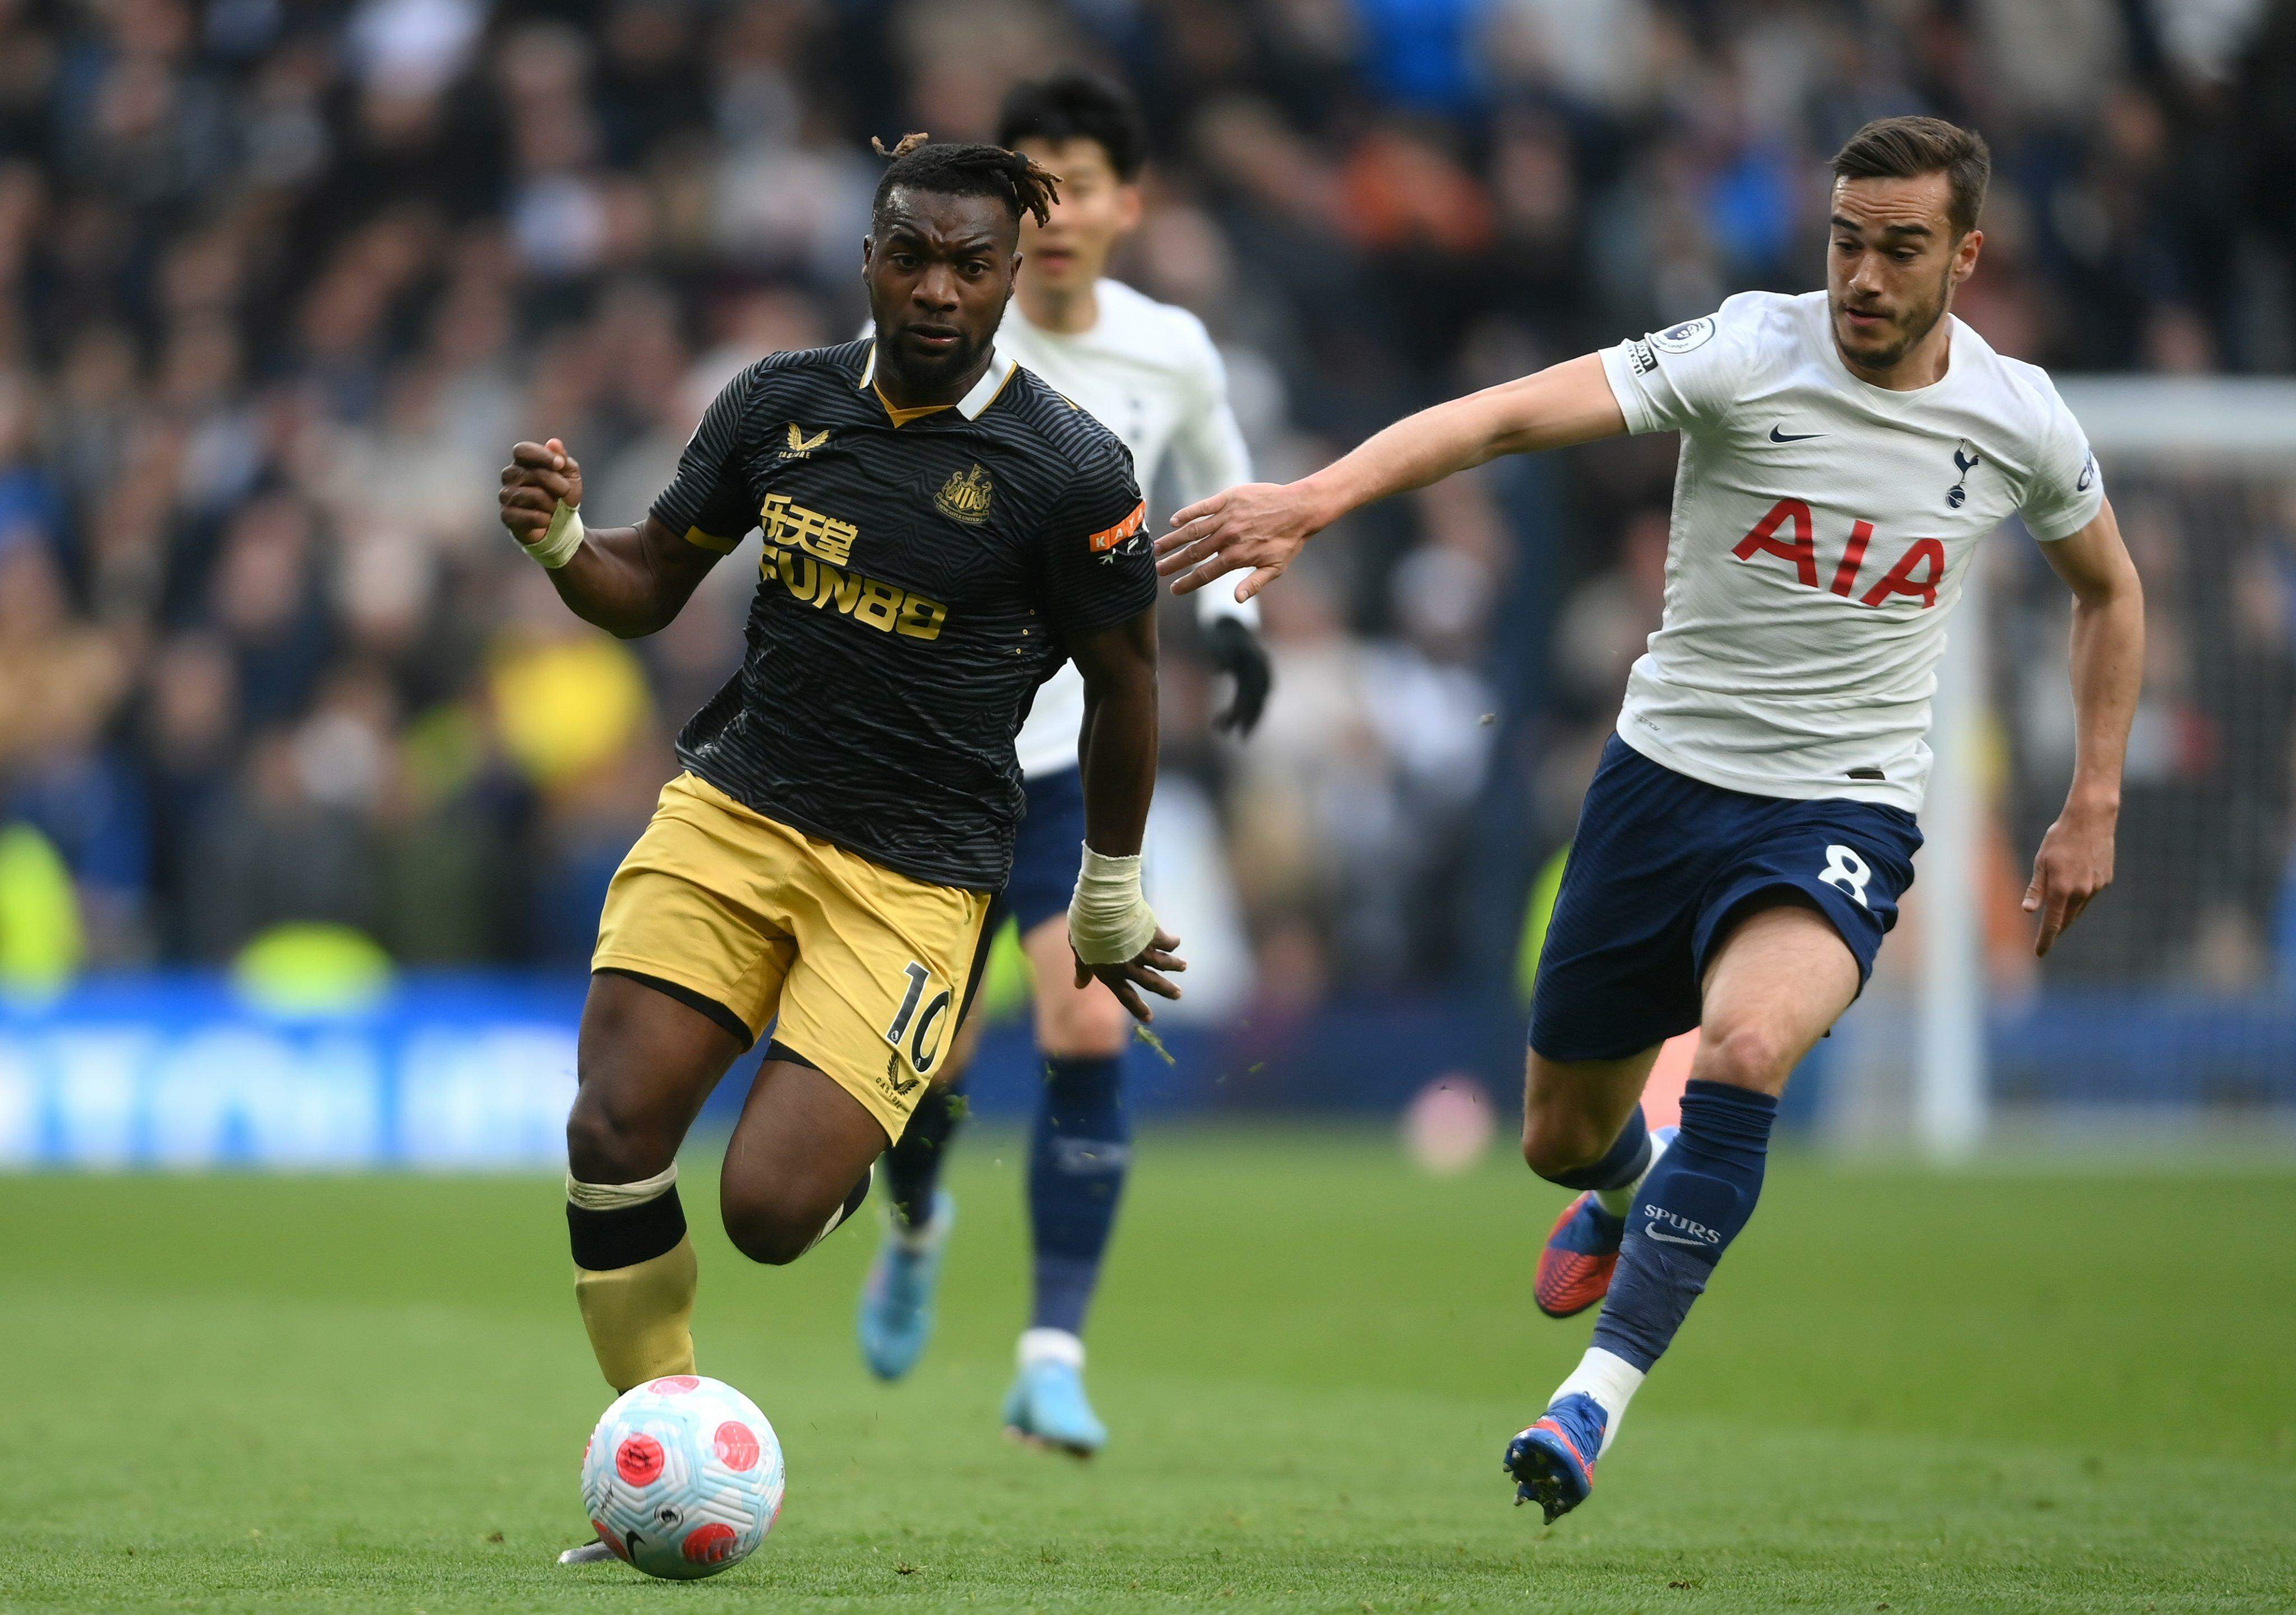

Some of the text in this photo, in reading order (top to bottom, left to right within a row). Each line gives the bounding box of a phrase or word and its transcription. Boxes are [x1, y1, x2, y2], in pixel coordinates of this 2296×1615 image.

[760, 493, 859, 567] 乐天堂
[1096, 507, 1143, 548] KAYA
[1731, 496, 1945, 609] AIA
[760, 544, 948, 640] FUN88
[1817, 844, 1872, 909] 8
[885, 959, 950, 1075] 10
[1644, 1204, 1721, 1244] SPURS
